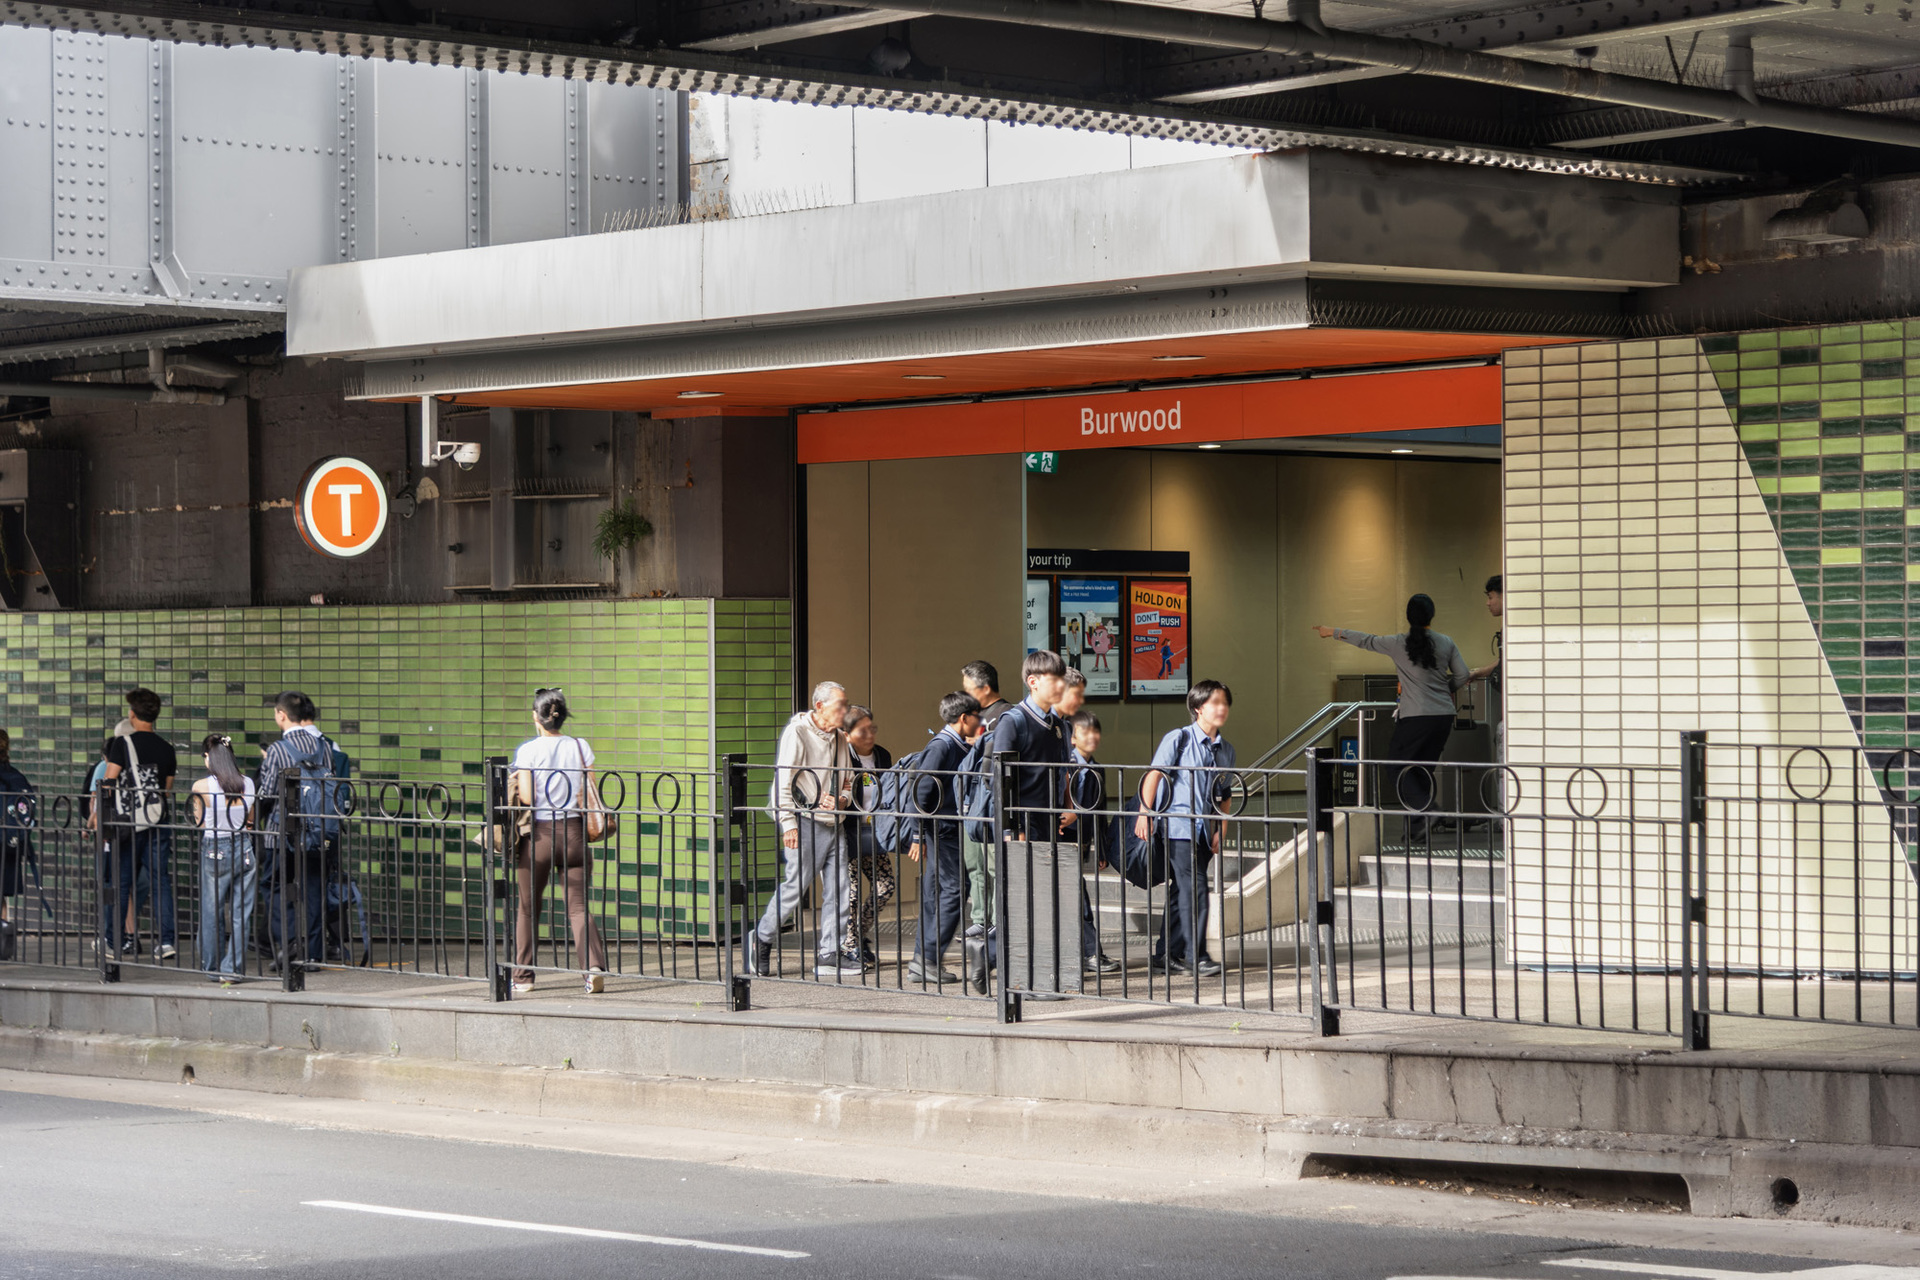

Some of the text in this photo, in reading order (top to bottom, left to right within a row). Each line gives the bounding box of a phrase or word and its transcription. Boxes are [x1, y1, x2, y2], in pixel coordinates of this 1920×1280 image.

[1081, 400, 1182, 436] Burwood
[328, 484, 363, 537] T
[1029, 554, 1072, 568] your trip
[1135, 591, 1182, 609] HOLD ON
[1136, 613, 1158, 623] DON'T
[1160, 617, 1180, 626] RUSH
